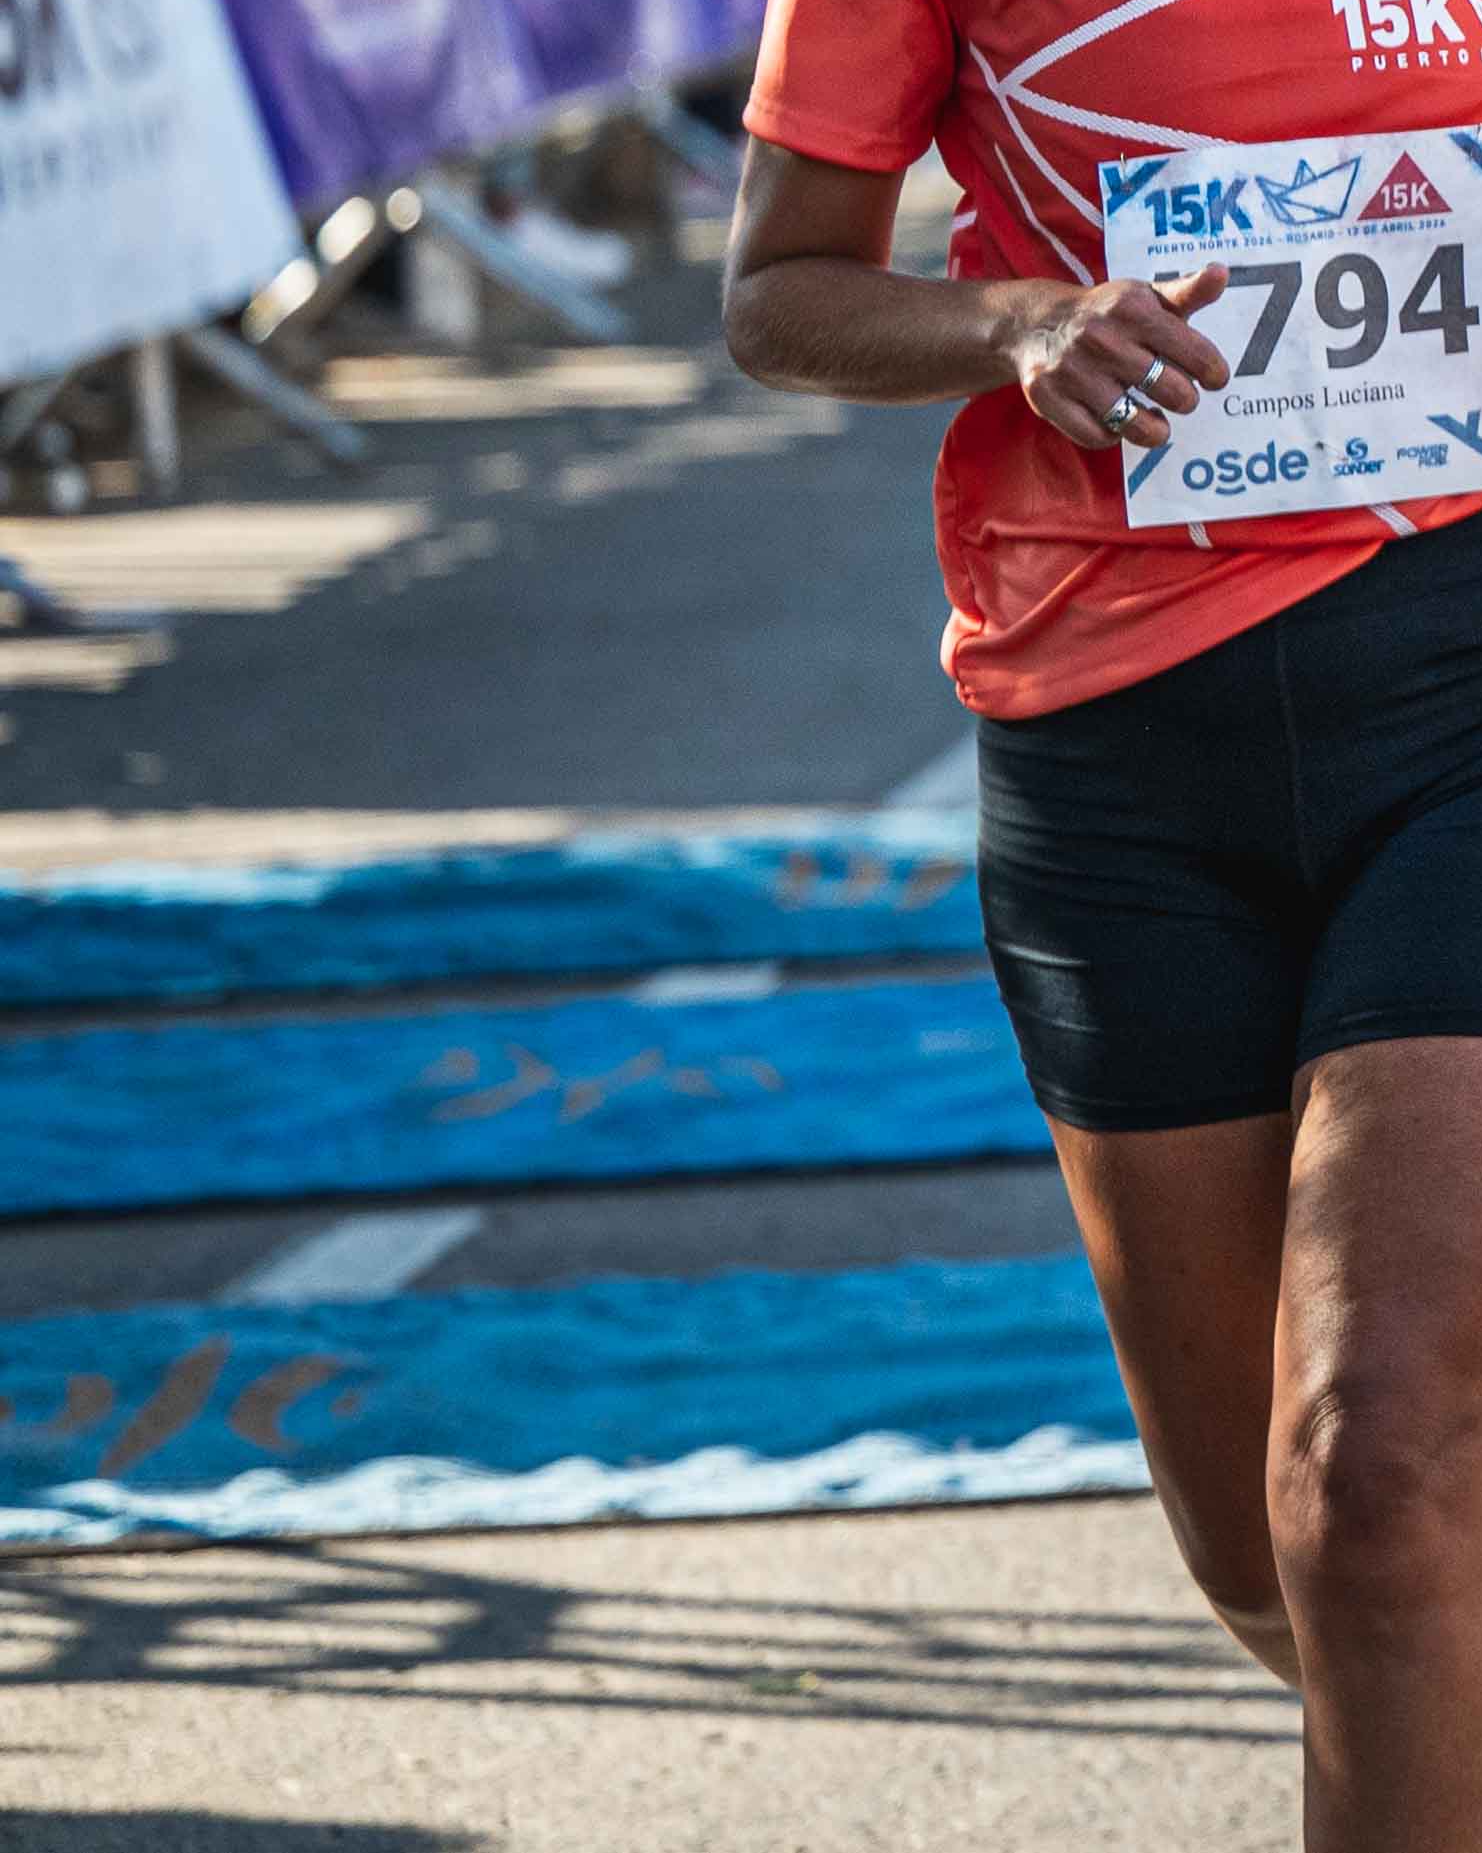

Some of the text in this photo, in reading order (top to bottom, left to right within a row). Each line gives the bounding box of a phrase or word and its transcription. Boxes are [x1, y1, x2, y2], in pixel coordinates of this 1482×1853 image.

[1352, 49, 1469, 72] PUERTO
[1144, 177, 1253, 238] 15K
[1380, 179, 1430, 210] 15K
[1148, 241, 1194, 255] PUERTO
[1200, 239, 1237, 250] NORTE
[1285, 230, 1335, 244] ROSARIO
[1154, 244, 1480, 378] 794
[1223, 380, 1405, 419] Campos Luciana
[1182, 439, 1309, 495] osde
